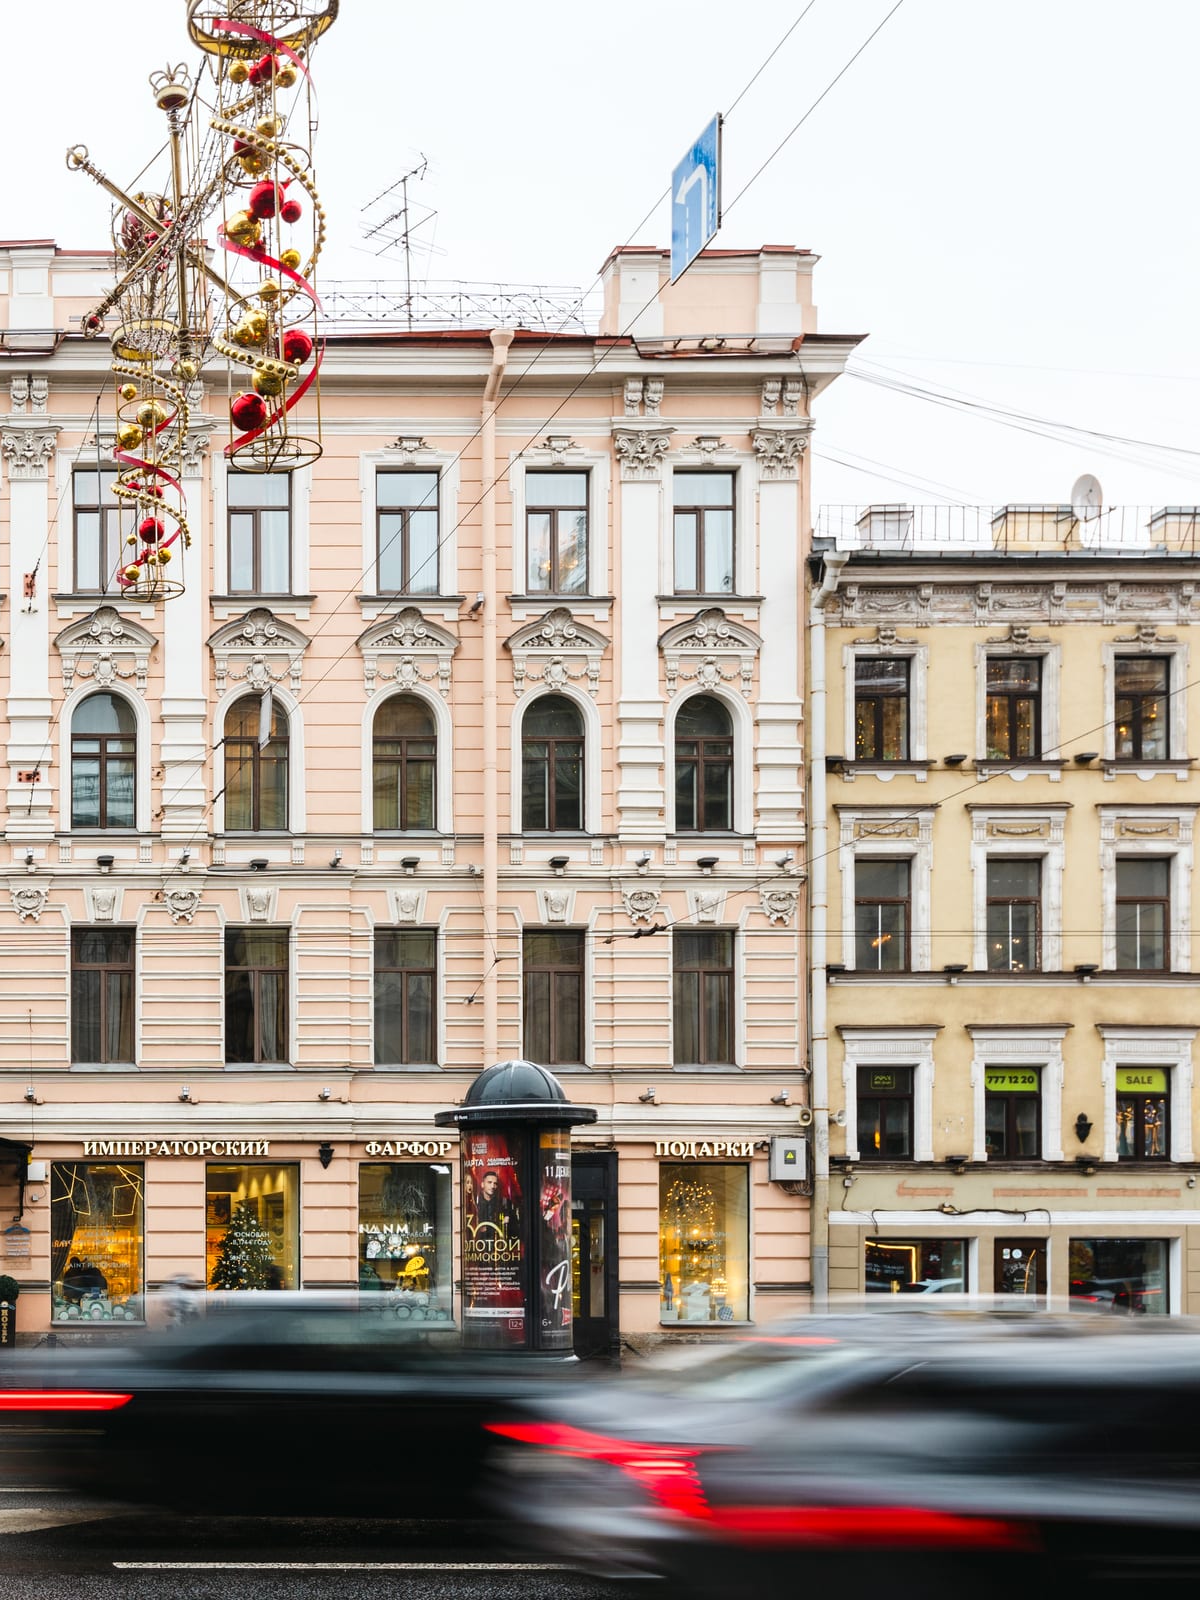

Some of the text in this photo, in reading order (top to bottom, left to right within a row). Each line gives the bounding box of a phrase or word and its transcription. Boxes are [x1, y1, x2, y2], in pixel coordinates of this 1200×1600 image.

[987, 1075, 1035, 1084] 777 12 20
[1126, 1076, 1153, 1085] SALE
[83, 1139, 269, 1156] ИМПЕРАТОРСКИЙ
[365, 1141, 452, 1156] ФАРФОР
[654, 1141, 755, 1160] ПОДАРКИ
[1, 1309, 9, 1343] HOTEL
